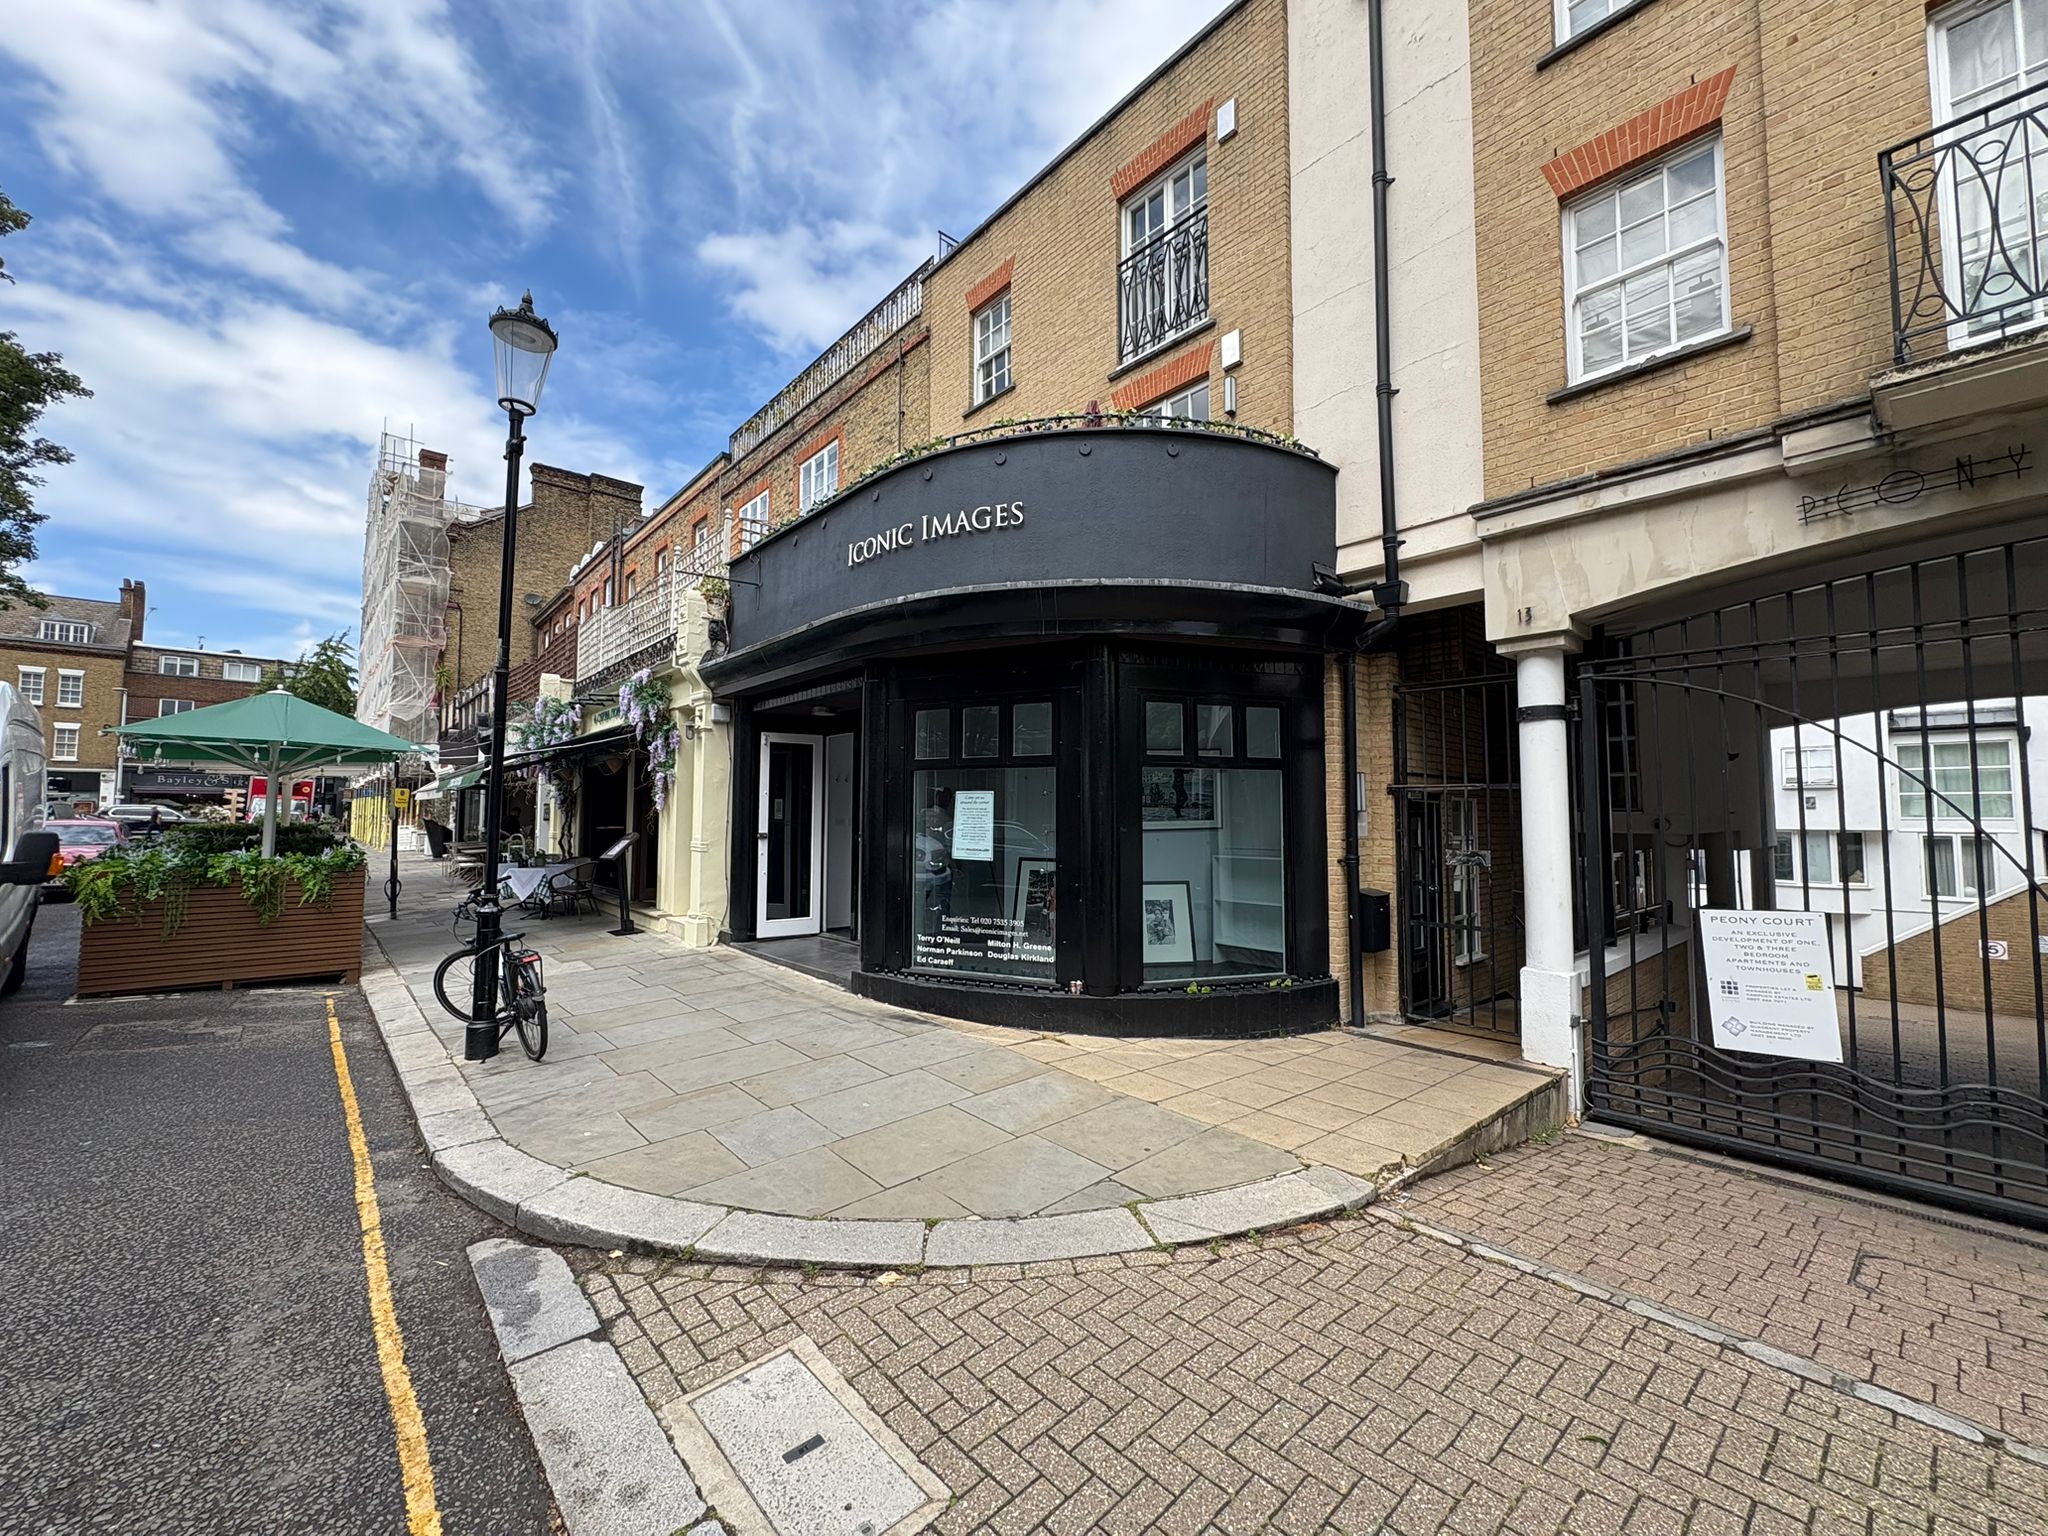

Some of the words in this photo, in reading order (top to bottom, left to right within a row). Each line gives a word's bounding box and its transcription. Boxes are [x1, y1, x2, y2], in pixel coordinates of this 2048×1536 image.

[848, 523, 913, 566] ICONIC
[921, 501, 1024, 540] IMAGES
[1517, 606, 1532, 625] 13
[158, 775, 202, 785] Bayley
[204, 774, 227, 786] &
[970, 916, 980, 924] Tel
[980, 917, 992, 925] 020
[993, 918, 1008, 926] 7535
[1009, 919, 1024, 927] 3905
[1710, 916, 1758, 925] PEONY
[1762, 917, 1814, 926] COURT
[941, 924, 959, 932] Email:
[917, 934, 935, 943] Terry
[936, 935, 961, 945] O'Neill
[1712, 936, 1778, 944] DEVELOPMENT
[917, 945, 945, 954] Norman
[946, 947, 983, 957] Parkinson
[987, 939, 1011, 948] Milton
[1023, 942, 1052, 952] Greene
[987, 951, 1019, 961] Douglas
[1021, 953, 1055, 963] Kirkland
[1726, 958, 1786, 966] APARTMENTS
[1736, 965, 1801, 974] TOWNHOUSES
